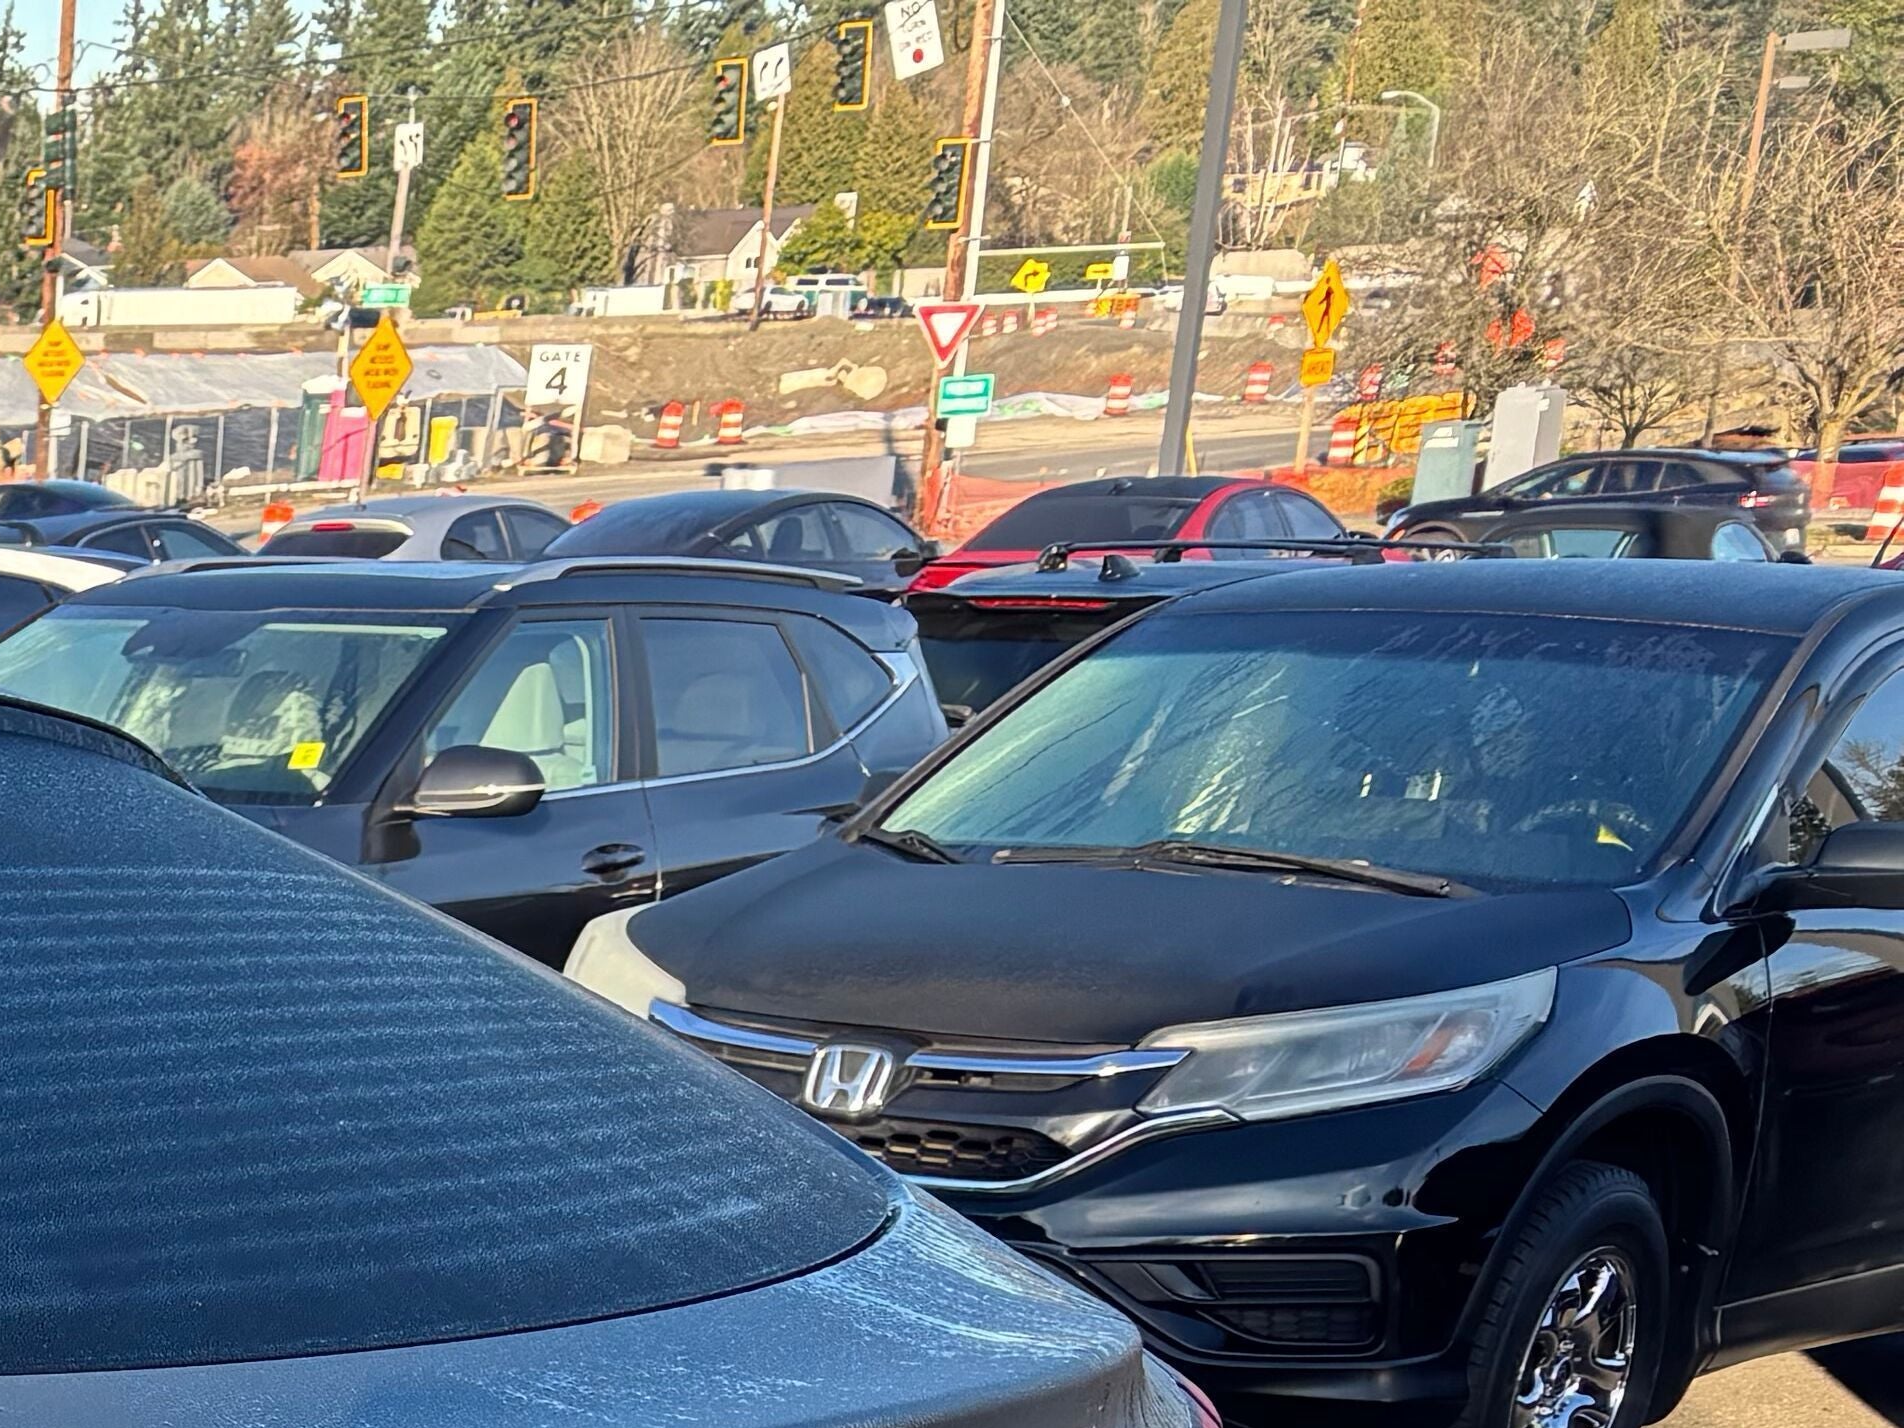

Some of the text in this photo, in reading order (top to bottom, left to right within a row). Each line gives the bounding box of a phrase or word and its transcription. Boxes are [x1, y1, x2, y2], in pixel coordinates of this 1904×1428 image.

[900, 2, 921, 18] NO
[539, 351, 581, 362] GATE
[545, 367, 568, 396] 4
